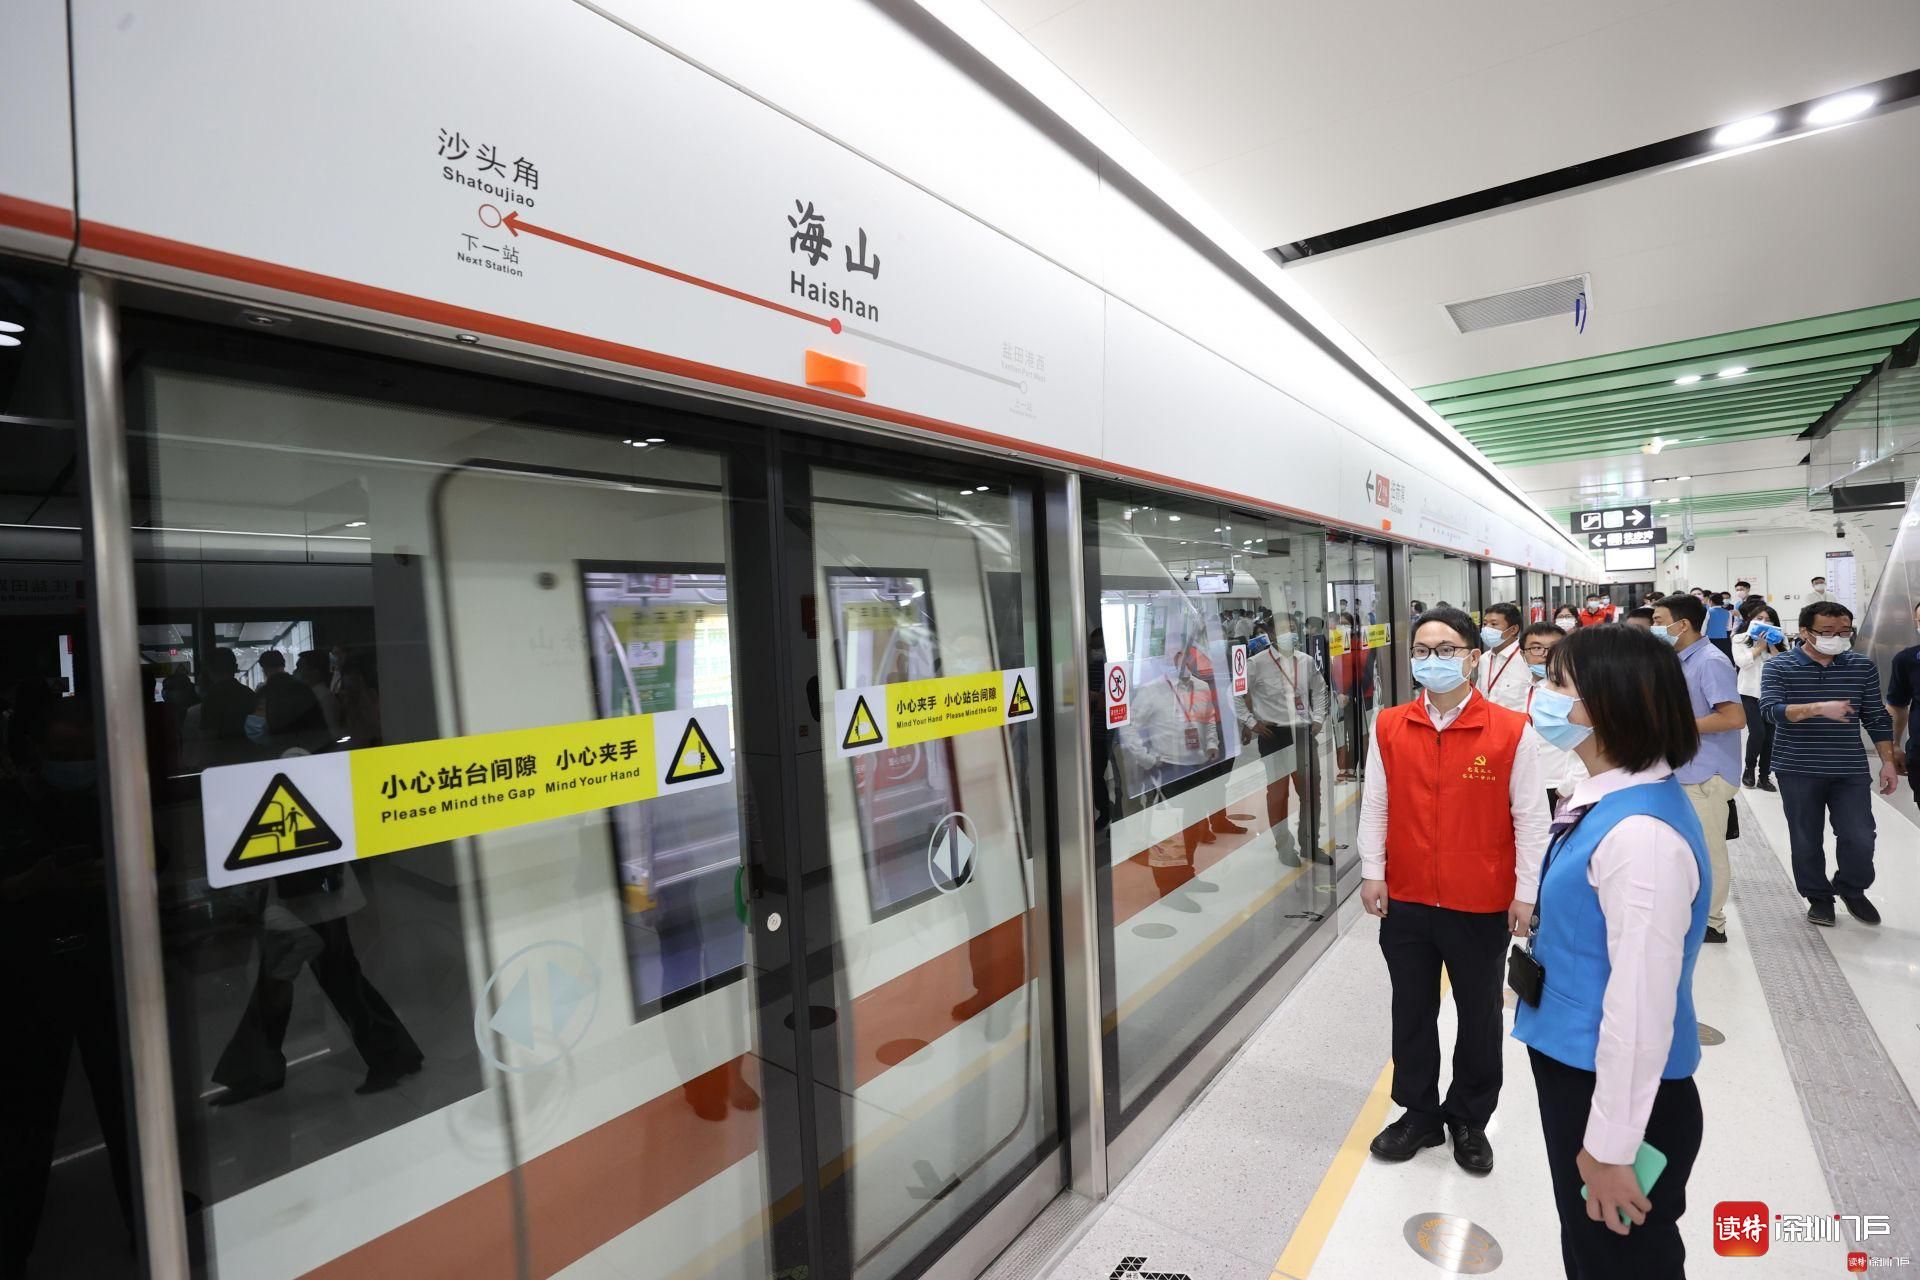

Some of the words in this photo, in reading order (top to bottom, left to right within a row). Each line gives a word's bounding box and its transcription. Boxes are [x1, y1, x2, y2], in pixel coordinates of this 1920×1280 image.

[437, 127, 539, 190] 沙头角
[443, 165, 535, 208] Shatoujiao
[461, 232, 519, 264] 下一站
[787, 198, 881, 280] 海山
[457, 251, 483, 267] Next
[485, 259, 523, 277] Station
[790, 270, 879, 322] Haishan
[896, 720, 912, 729] Mind
[913, 718, 927, 726] Your
[928, 715, 943, 723] Hand
[946, 712, 965, 720] Please
[965, 708, 978, 717] Mind
[987, 705, 998, 714] Gap
[897, 696, 937, 715] 小心夹手
[944, 687, 997, 708] 小心站台间隙
[381, 755, 538, 800] 小心站台间隙
[556, 739, 639, 771] 小心夹手
[381, 804, 437, 823] Please
[441, 796, 478, 812] Mind
[482, 791, 504, 805] the
[508, 787, 535, 801] Gap
[546, 779, 577, 794] Mind
[579, 774, 608, 787] Your
[611, 767, 640, 781] Hand
